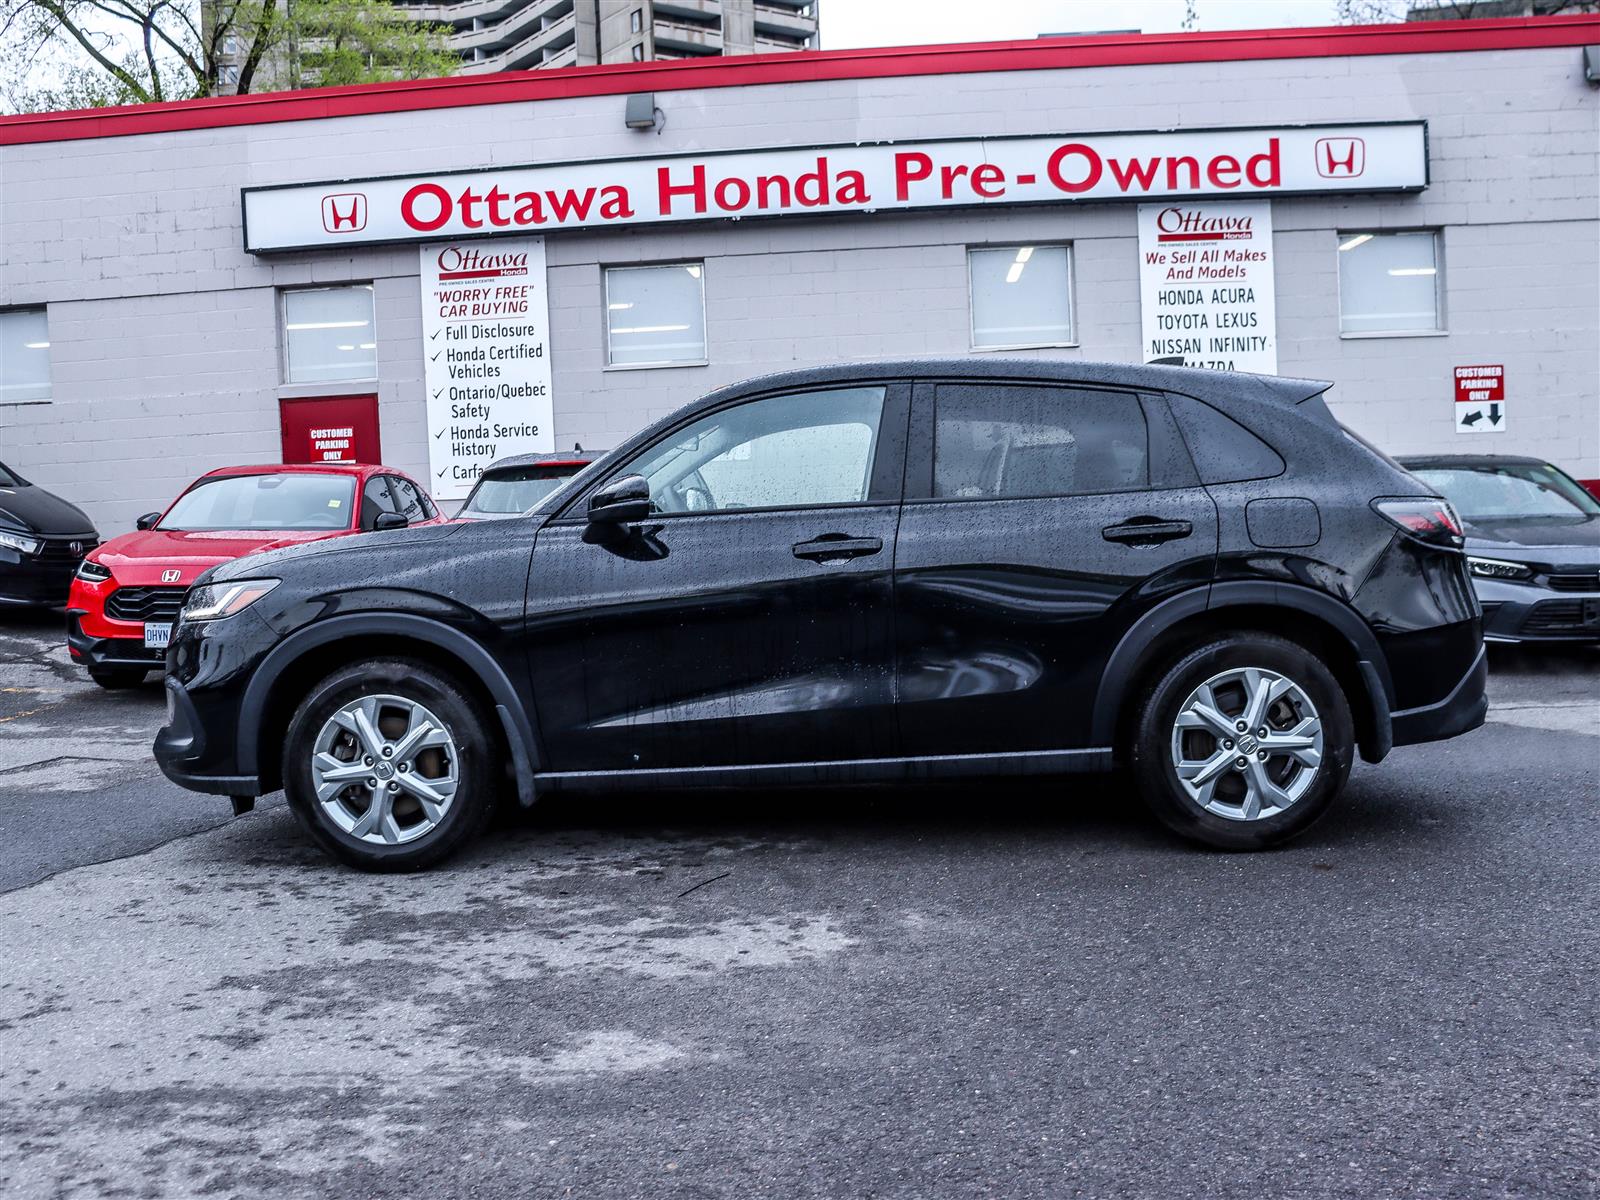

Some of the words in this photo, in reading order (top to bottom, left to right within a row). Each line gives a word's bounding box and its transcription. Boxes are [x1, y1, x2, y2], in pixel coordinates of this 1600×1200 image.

[401, 183, 635, 231] Ottawa
[657, 157, 871, 216] Honda
[894, 138, 1281, 202] Pre-Owned
[1157, 207, 1252, 233] Ottawa
[1223, 232, 1251, 240] Honda
[437, 247, 528, 272] Ottawa
[1146, 252, 1166, 264] We
[1171, 251, 1196, 264] Sell
[1200, 250, 1219, 263] All
[1223, 249, 1267, 262] Makes
[1166, 266, 1193, 279] And
[1198, 265, 1246, 279] Models
[1158, 290, 1204, 305] HONDA
[1211, 288, 1255, 304] ACURA
[440, 304, 468, 318] CAR
[472, 300, 528, 316] BUYING
[1157, 313, 1208, 330] TOYOTA
[1216, 312, 1258, 328] LEXUS
[446, 325, 467, 340] Full
[472, 323, 534, 339] Disclosure
[447, 346, 485, 362] Honda
[489, 343, 543, 360] Certified
[1152, 338, 1201, 354] NISSAN
[1210, 336, 1267, 353] INFINITY
[448, 363, 500, 379] Vehicles
[1456, 367, 1502, 377] CUSTOMER
[449, 382, 546, 401] Ontario/Quebec
[1460, 378, 1498, 389] PARKING
[1469, 390, 1490, 400] ONLY
[451, 403, 490, 421] Safety
[311, 428, 353, 439] CUSTOMER
[451, 424, 489, 440] Honda
[493, 422, 539, 438] Service
[315, 439, 349, 450] PARKING
[452, 442, 496, 459] History
[323, 450, 342, 461] ONLY
[453, 463, 484, 479] Carfa
